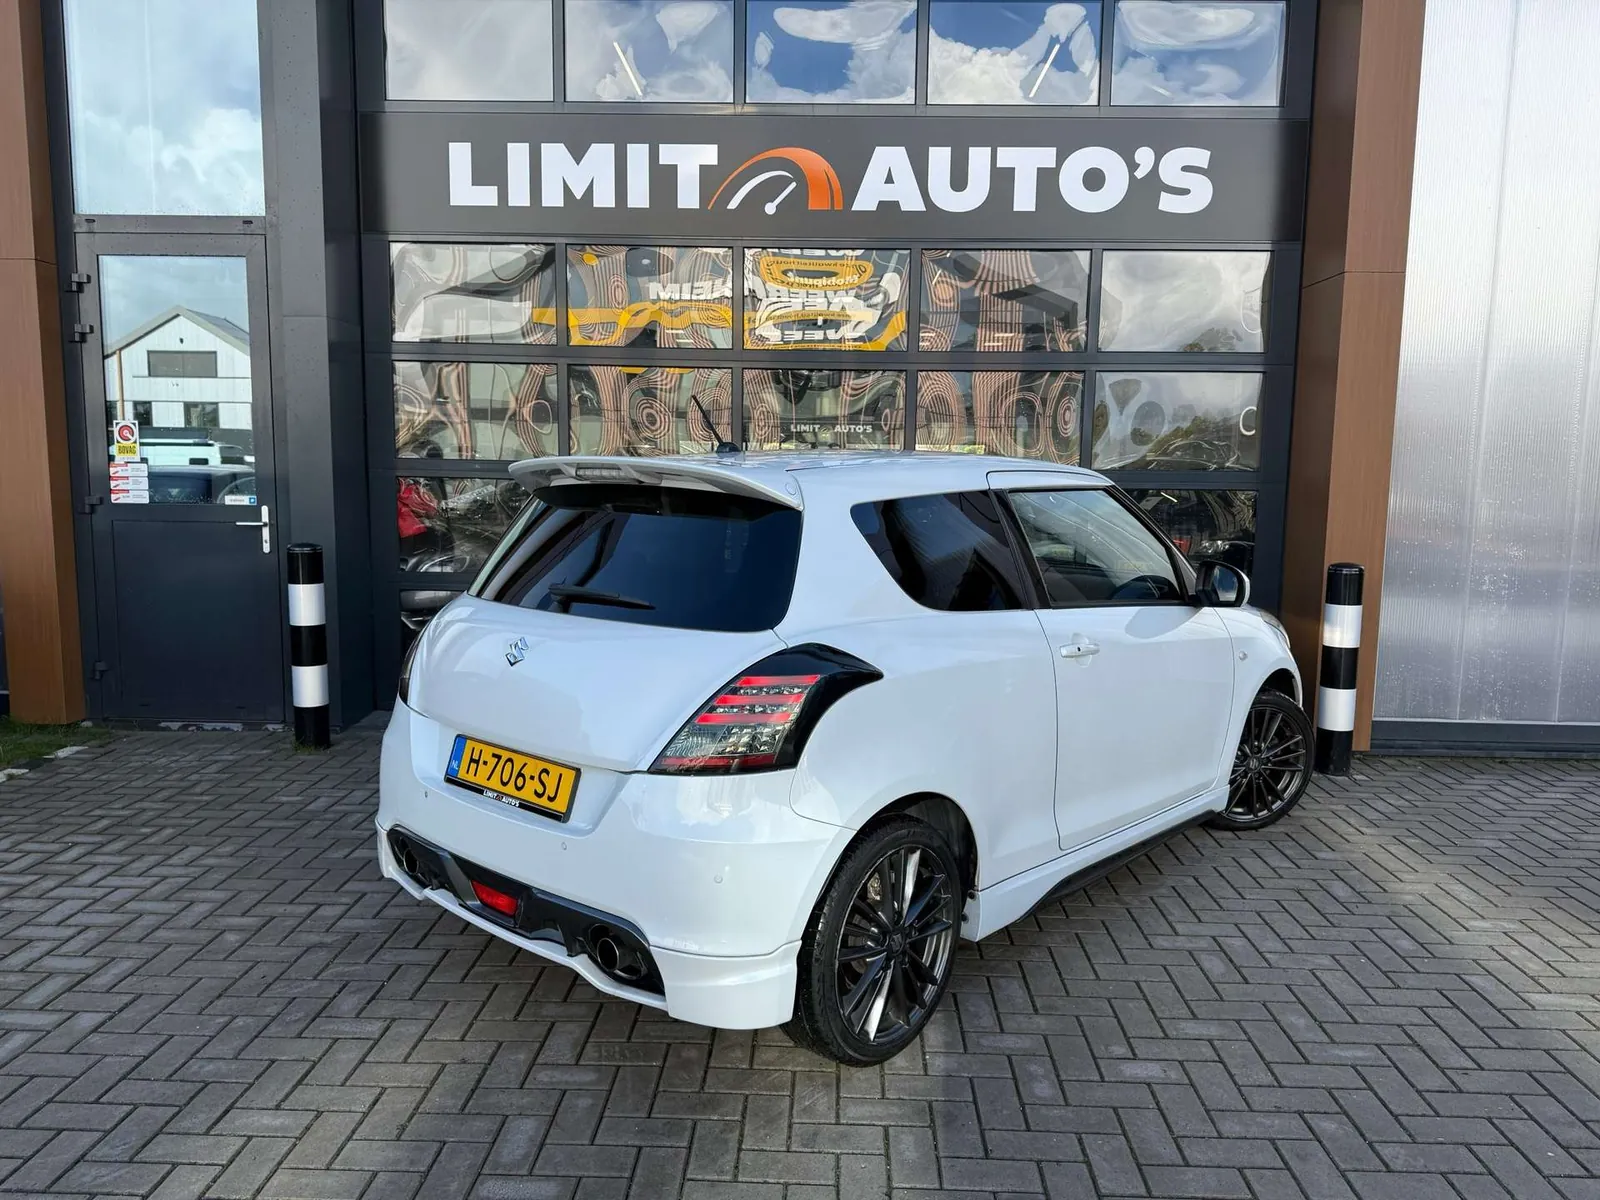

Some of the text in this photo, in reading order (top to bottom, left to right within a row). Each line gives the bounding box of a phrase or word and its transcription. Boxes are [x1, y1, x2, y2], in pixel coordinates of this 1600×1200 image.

[448, 142, 1213, 214] LIMIT AUTO'S
[790, 424, 873, 433] LIMIT AUTO'S
[118, 445, 136, 455] BOVAG
[452, 760, 459, 770] NL
[466, 747, 563, 803] H-706-SJ
[483, 789, 497, 800] LIMIT
